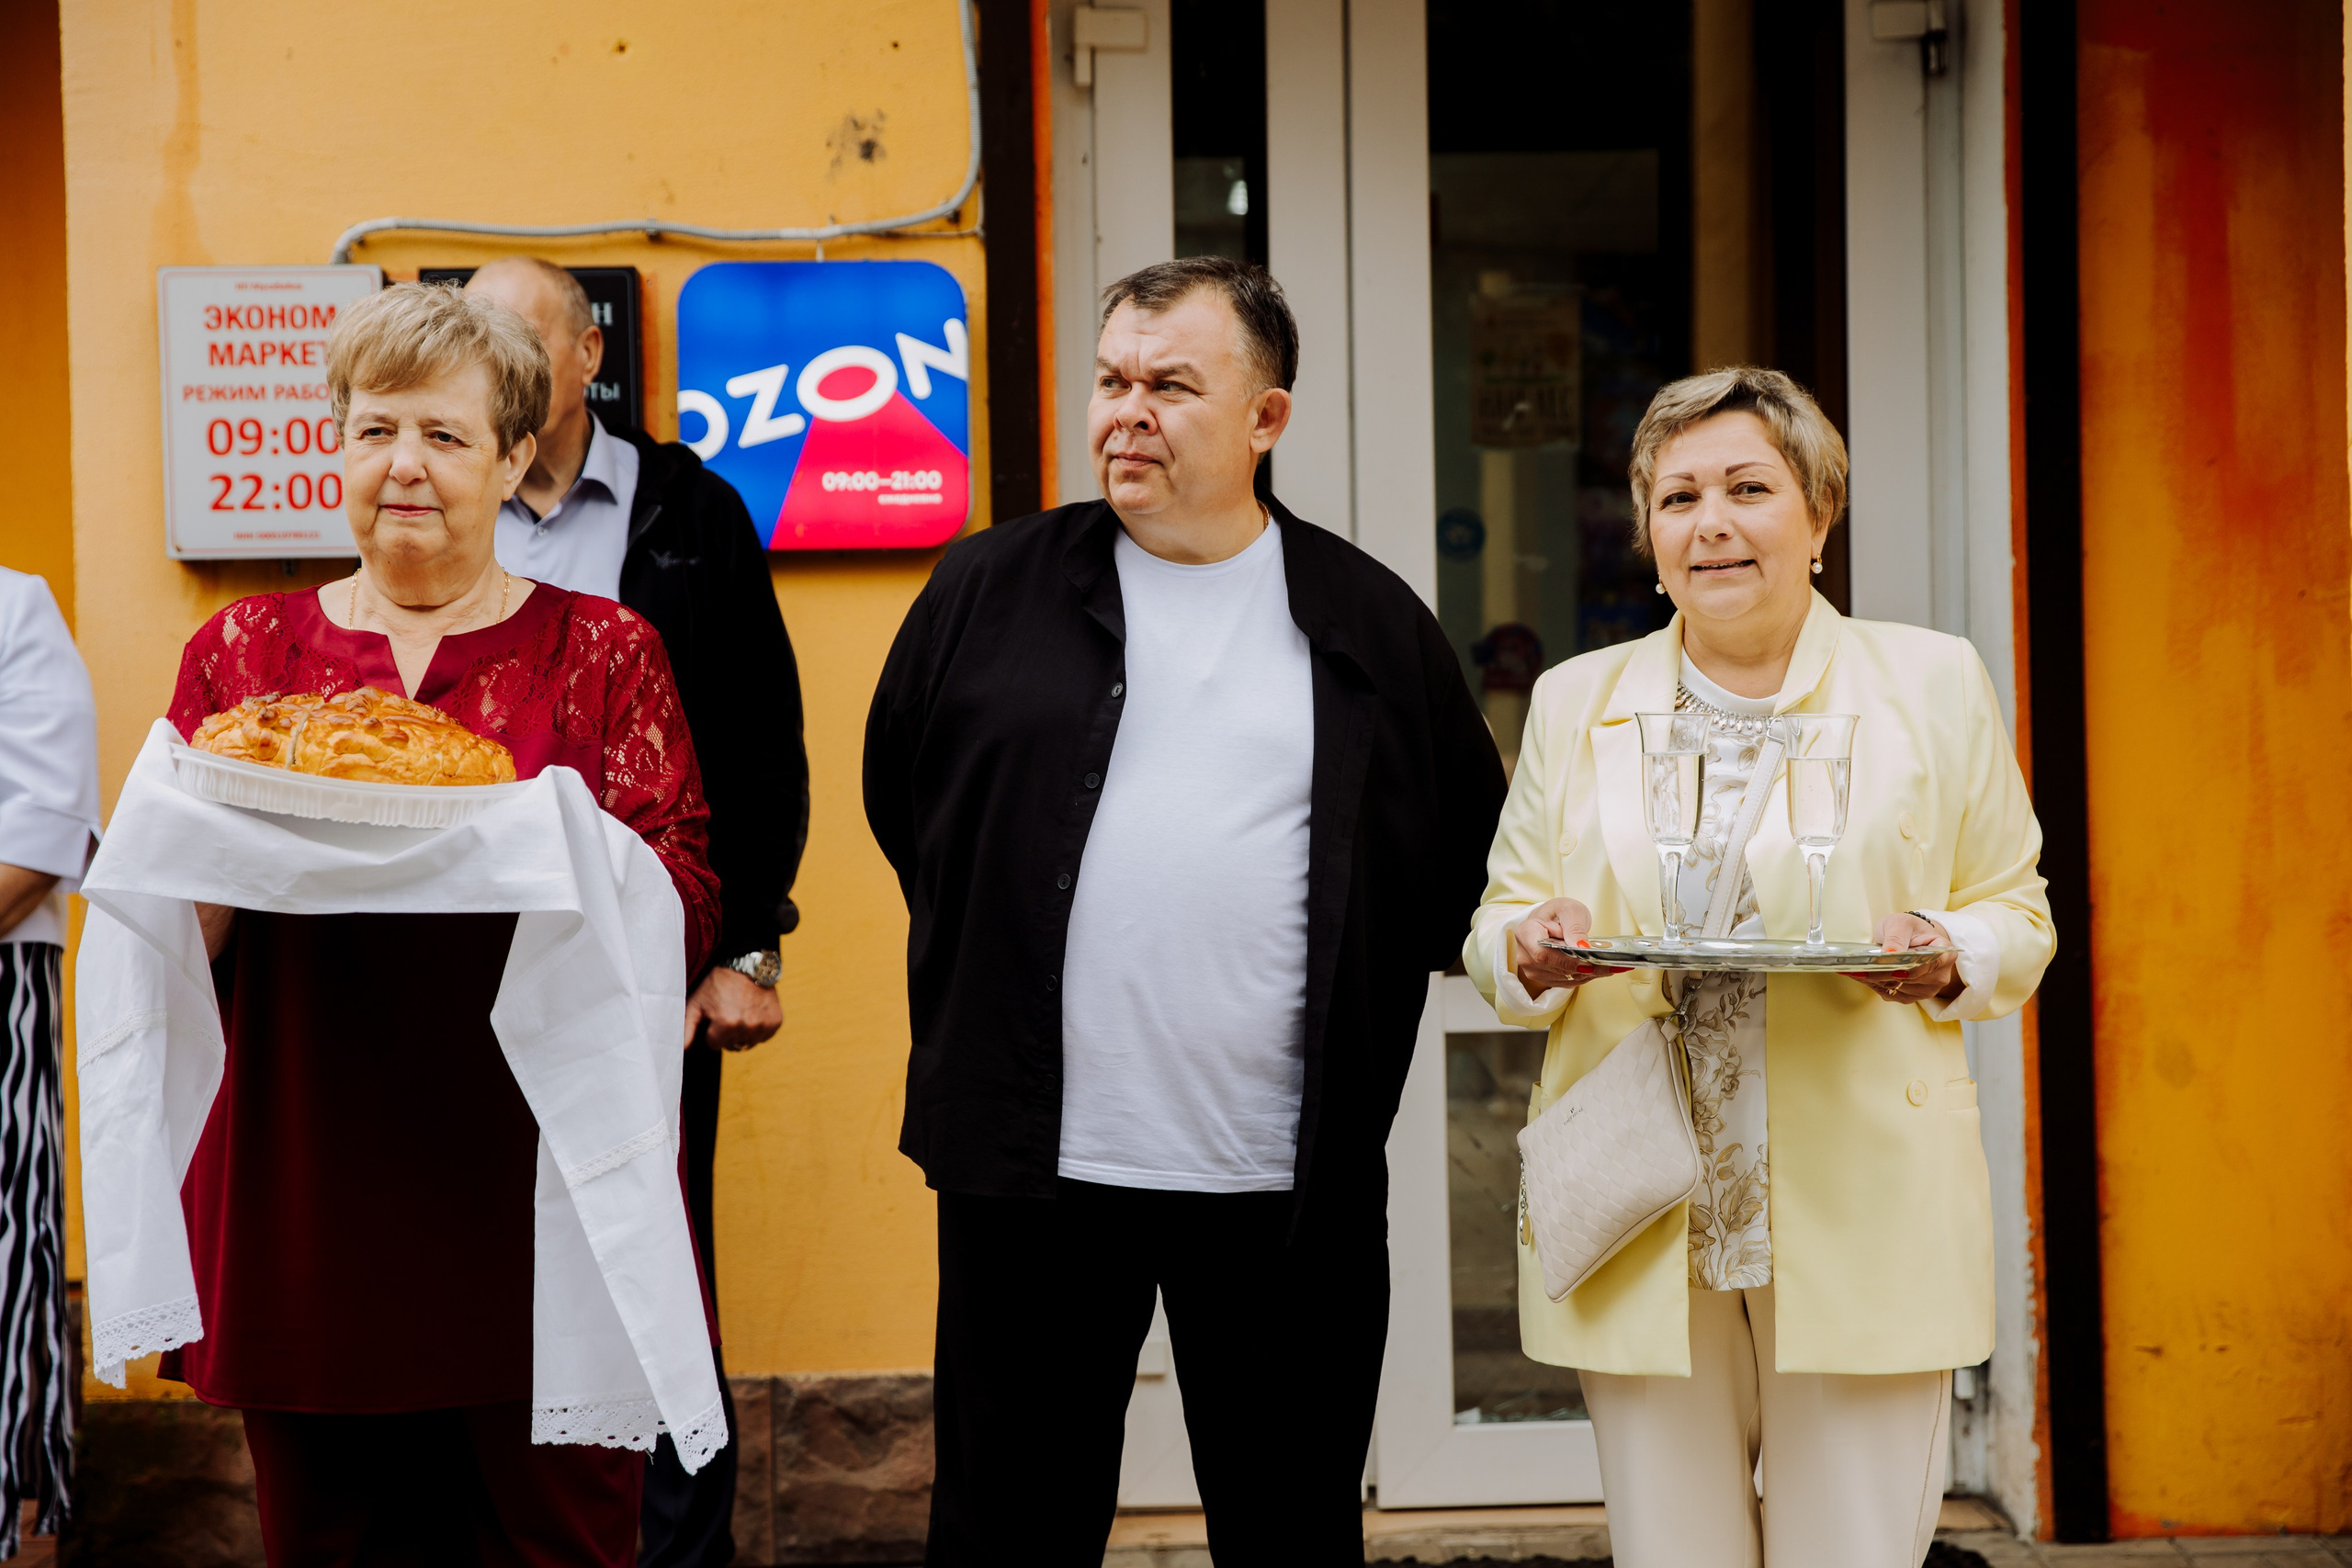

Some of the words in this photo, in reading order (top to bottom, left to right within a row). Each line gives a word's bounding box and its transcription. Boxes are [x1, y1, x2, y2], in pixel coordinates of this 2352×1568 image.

[204, 305, 335, 331] ЭКОНОМ
[183, 384, 266, 401] РЕЖИМ
[274, 383, 330, 400] РАБО
[677, 317, 968, 462] OZON
[207, 418, 339, 456] 09:00
[209, 473, 343, 511] 22:00
